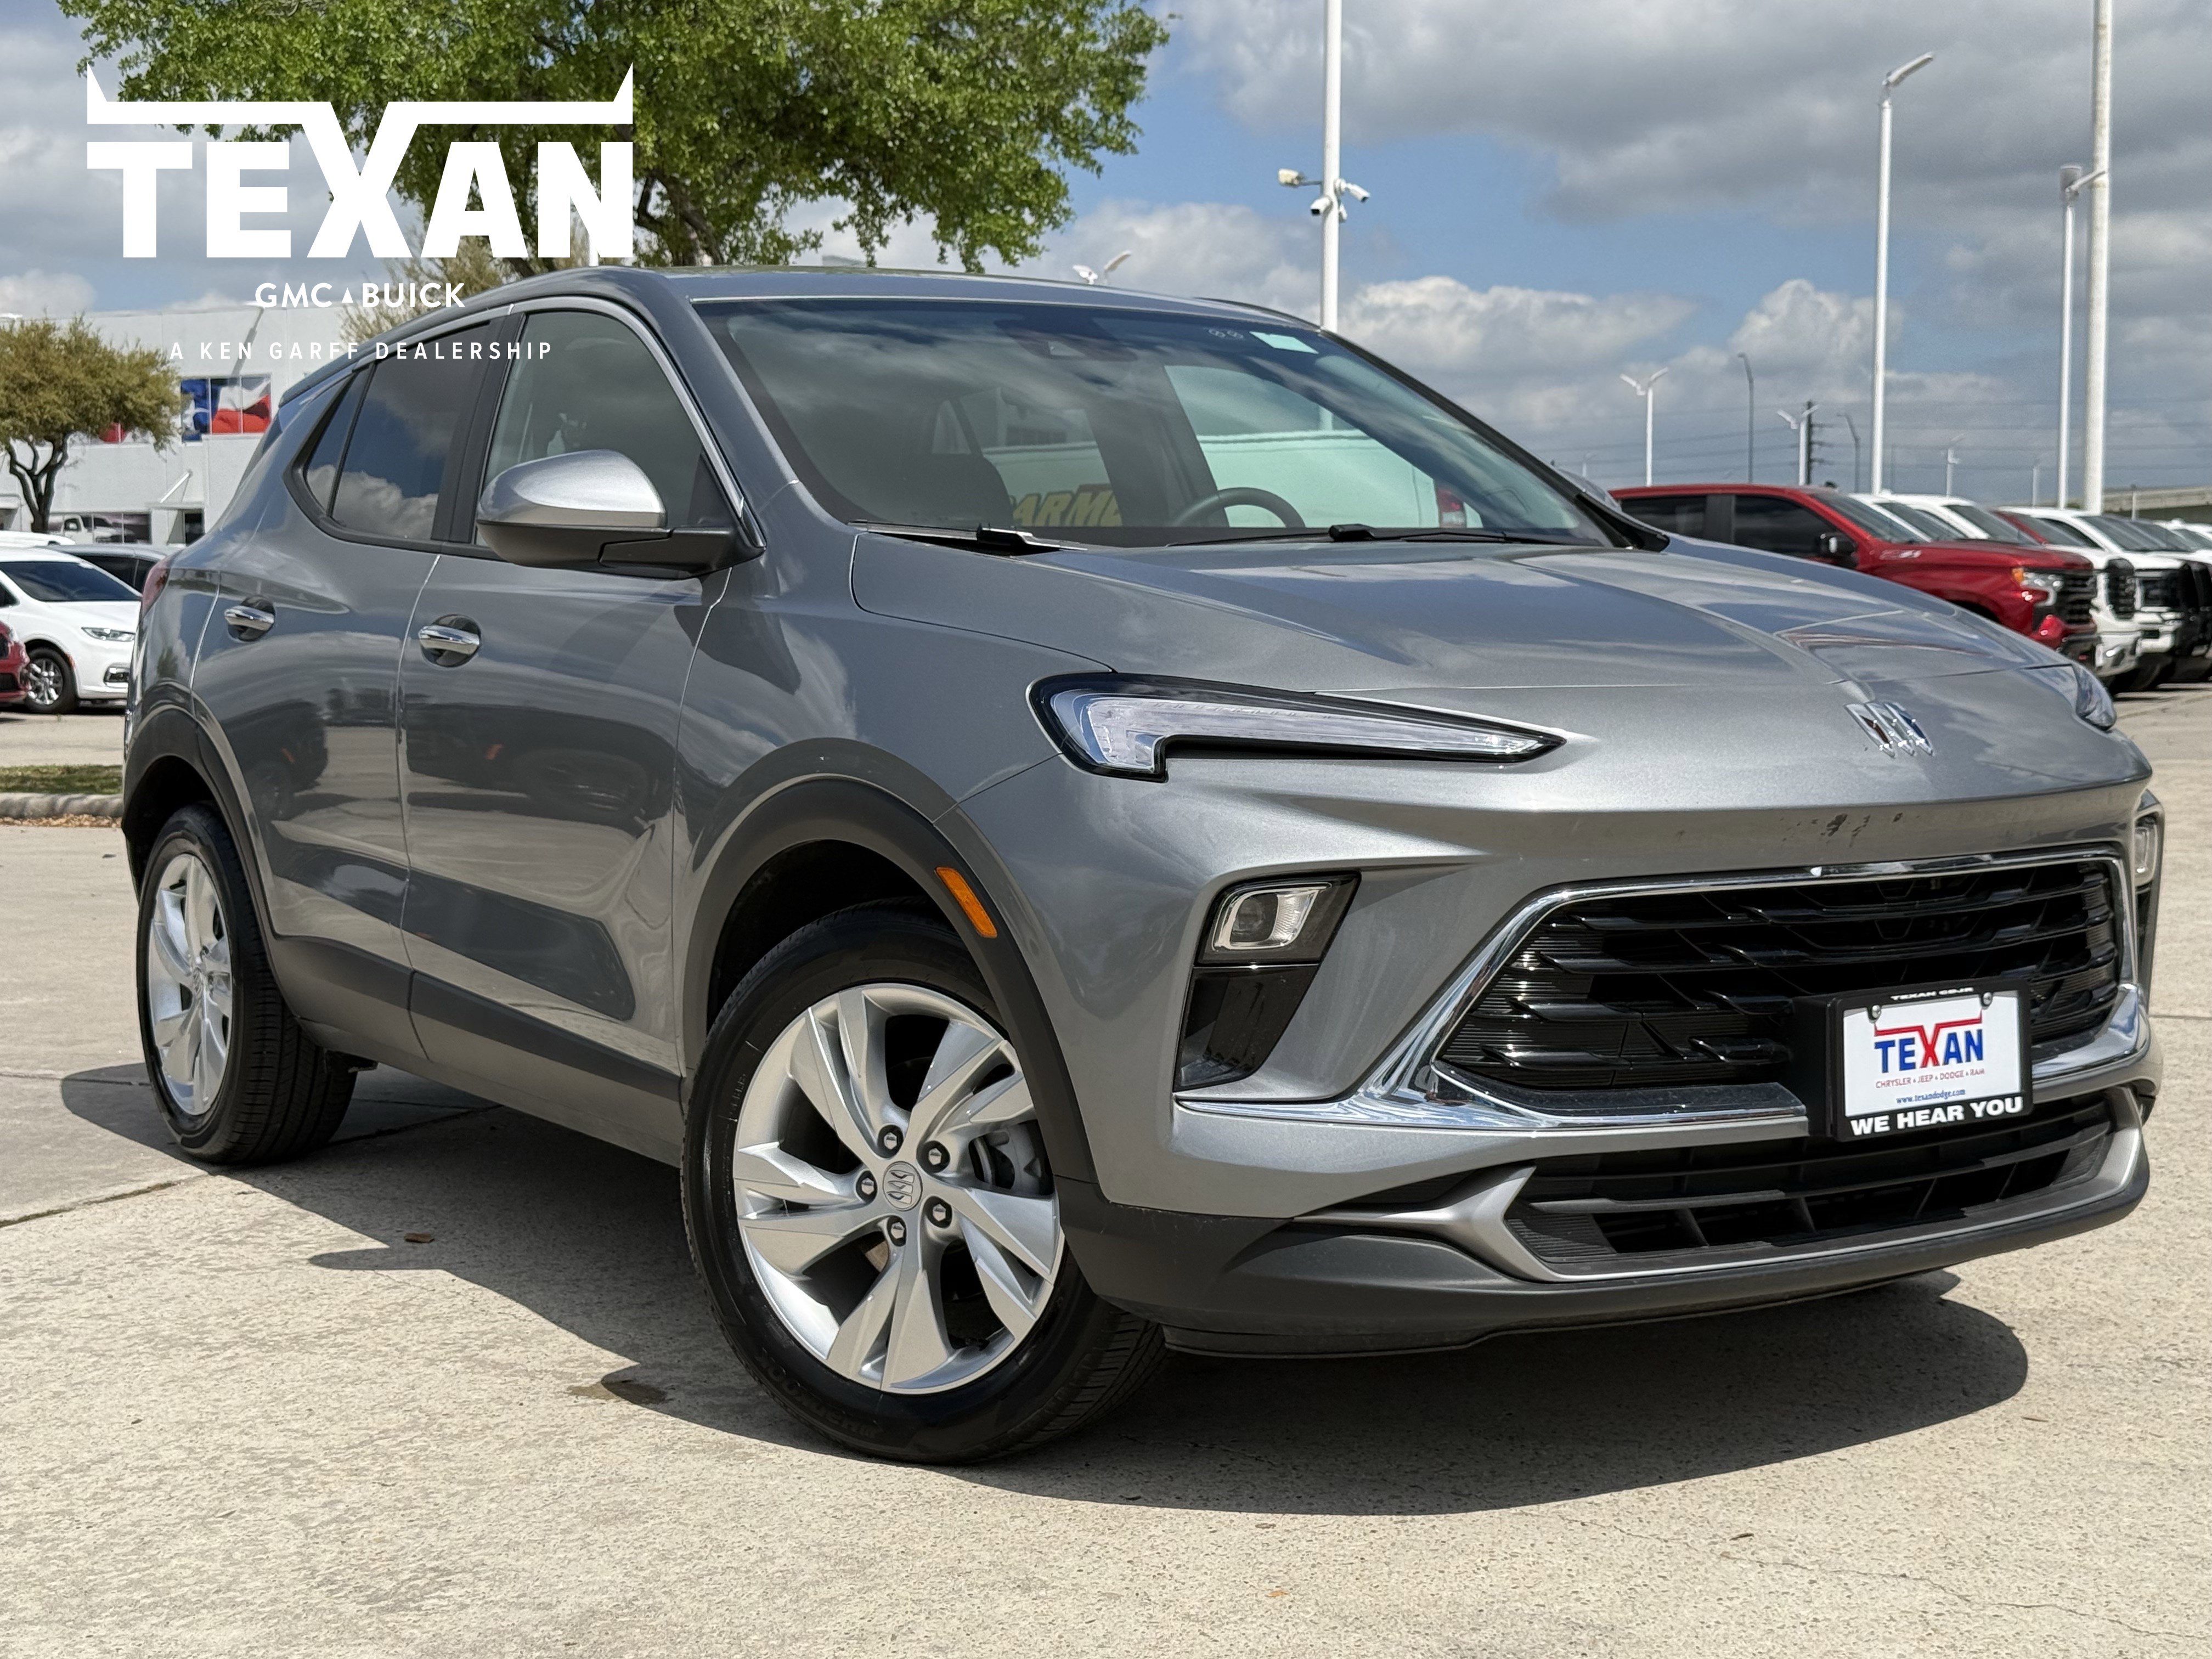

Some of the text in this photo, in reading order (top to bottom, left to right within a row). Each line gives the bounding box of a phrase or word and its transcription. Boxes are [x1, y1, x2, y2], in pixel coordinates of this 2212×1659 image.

[1891, 991, 1937, 1001] TEXAN
[1874, 1022, 1984, 1073] TEXAN
[1876, 1077, 1911, 1088] CHRYSLER
[1917, 1074, 1933, 1084] JEEP
[1940, 1070, 1964, 1080] DODGE
[1896, 1089, 1966, 1104] www.texandodge.com
[1850, 1097, 2023, 1136] WE HEAR YOU
